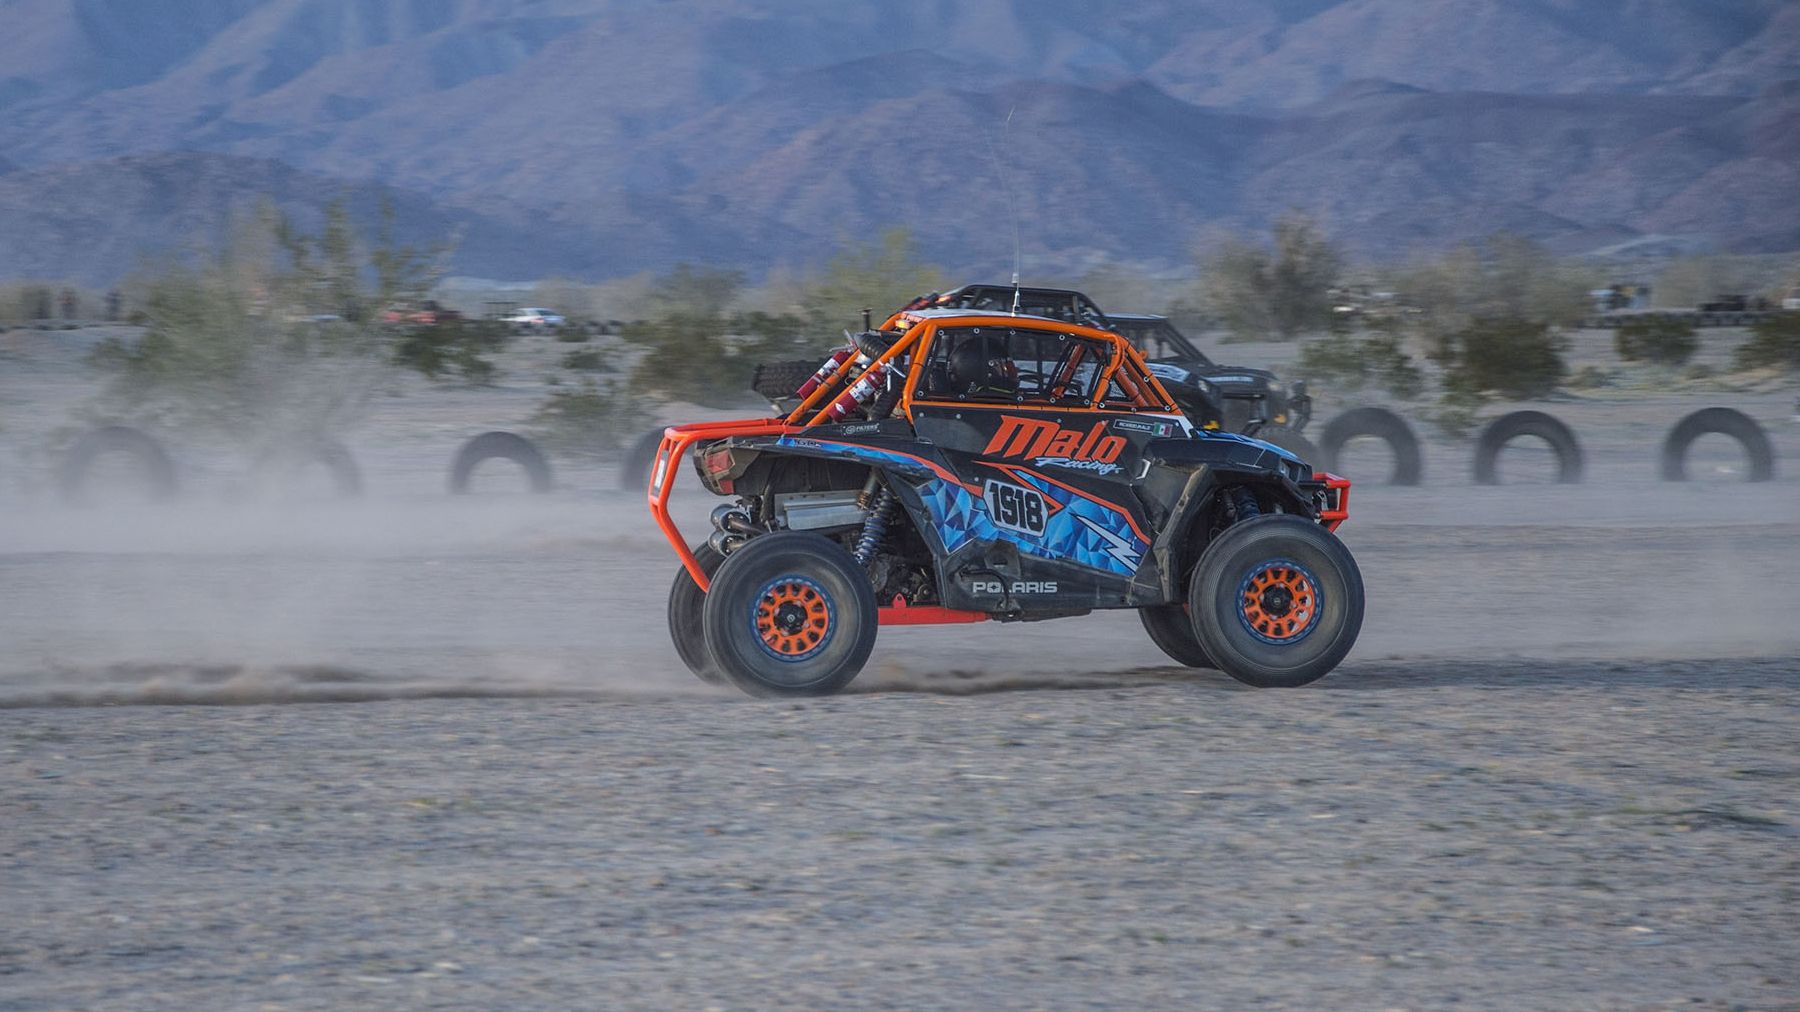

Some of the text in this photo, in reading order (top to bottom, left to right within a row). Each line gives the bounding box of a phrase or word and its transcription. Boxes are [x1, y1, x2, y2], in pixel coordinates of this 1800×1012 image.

[982, 415, 1127, 463] Malo
[1035, 457, 1123, 475] Racing
[989, 482, 1044, 532] 1918
